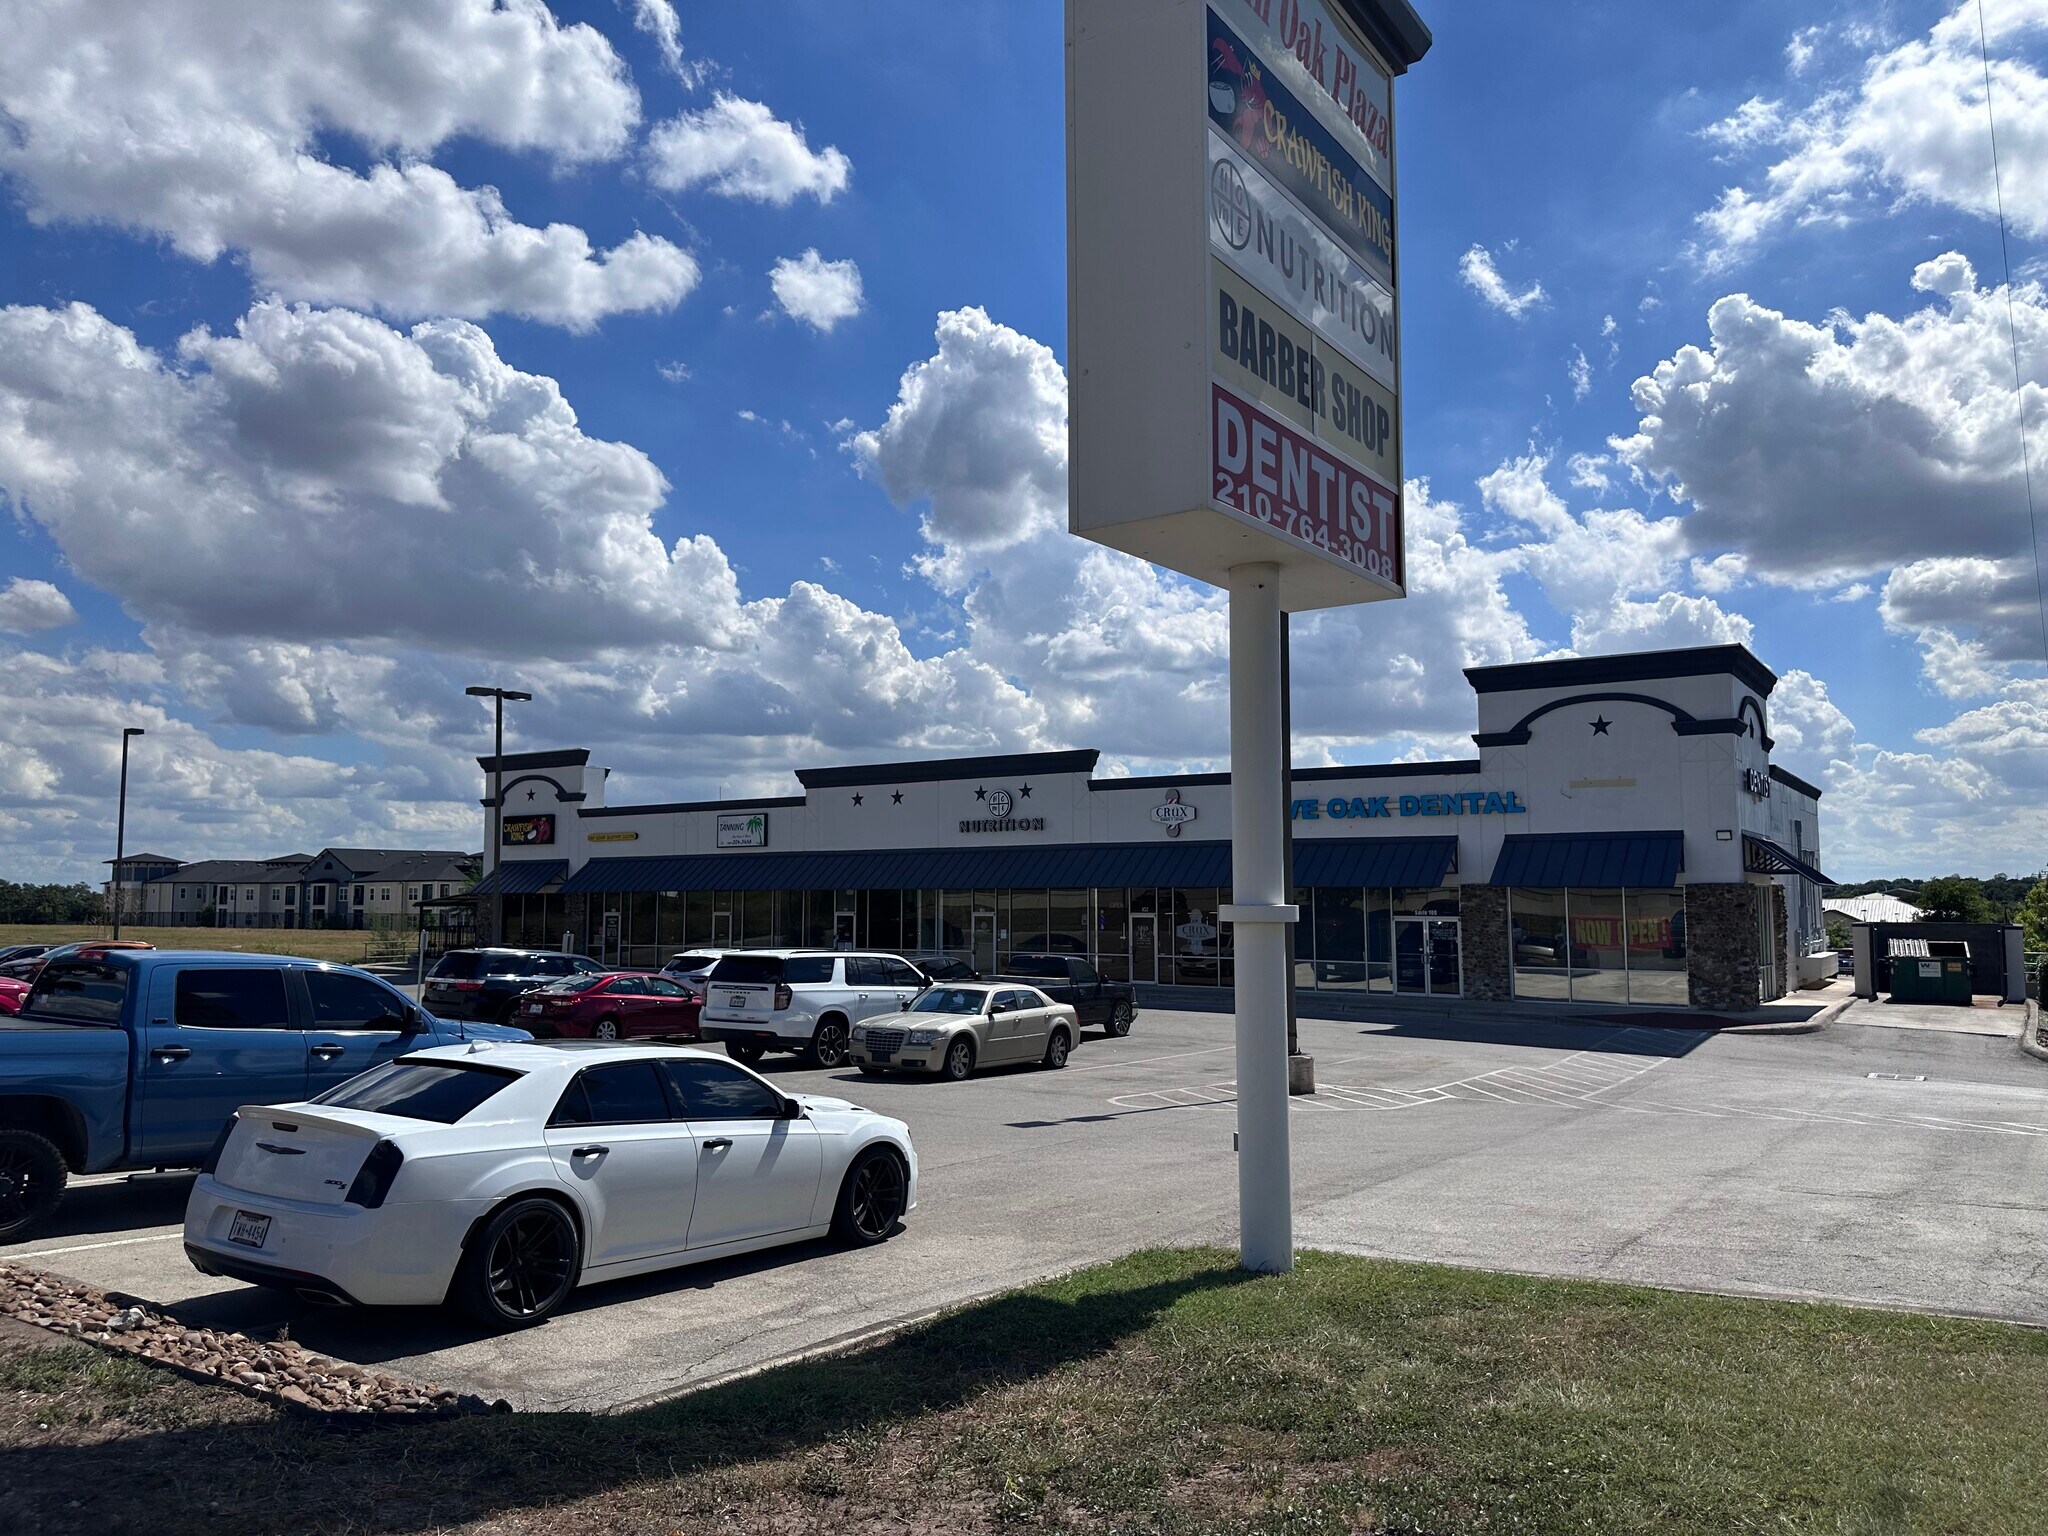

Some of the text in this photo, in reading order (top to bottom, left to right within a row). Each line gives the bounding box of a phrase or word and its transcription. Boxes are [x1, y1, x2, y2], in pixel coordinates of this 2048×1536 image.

[1280, 0, 1389, 159] Oak Plaza
[1263, 99, 1393, 264] CRAWFISH KING
[1257, 208, 1393, 361] NUTRITION
[1219, 288, 1390, 458] BARBER SHOP
[1217, 398, 1393, 552] DENTIST
[1215, 472, 1394, 581] 210-764-3008
[503, 822, 533, 833] CRAWFISH
[510, 832, 525, 841] KING
[719, 822, 745, 832] TANNING
[959, 817, 1044, 833] NUTRITION
[1326, 796, 1391, 818] OAK
[1398, 791, 1526, 817] DENTAL
[1575, 919, 1612, 945] NOW
